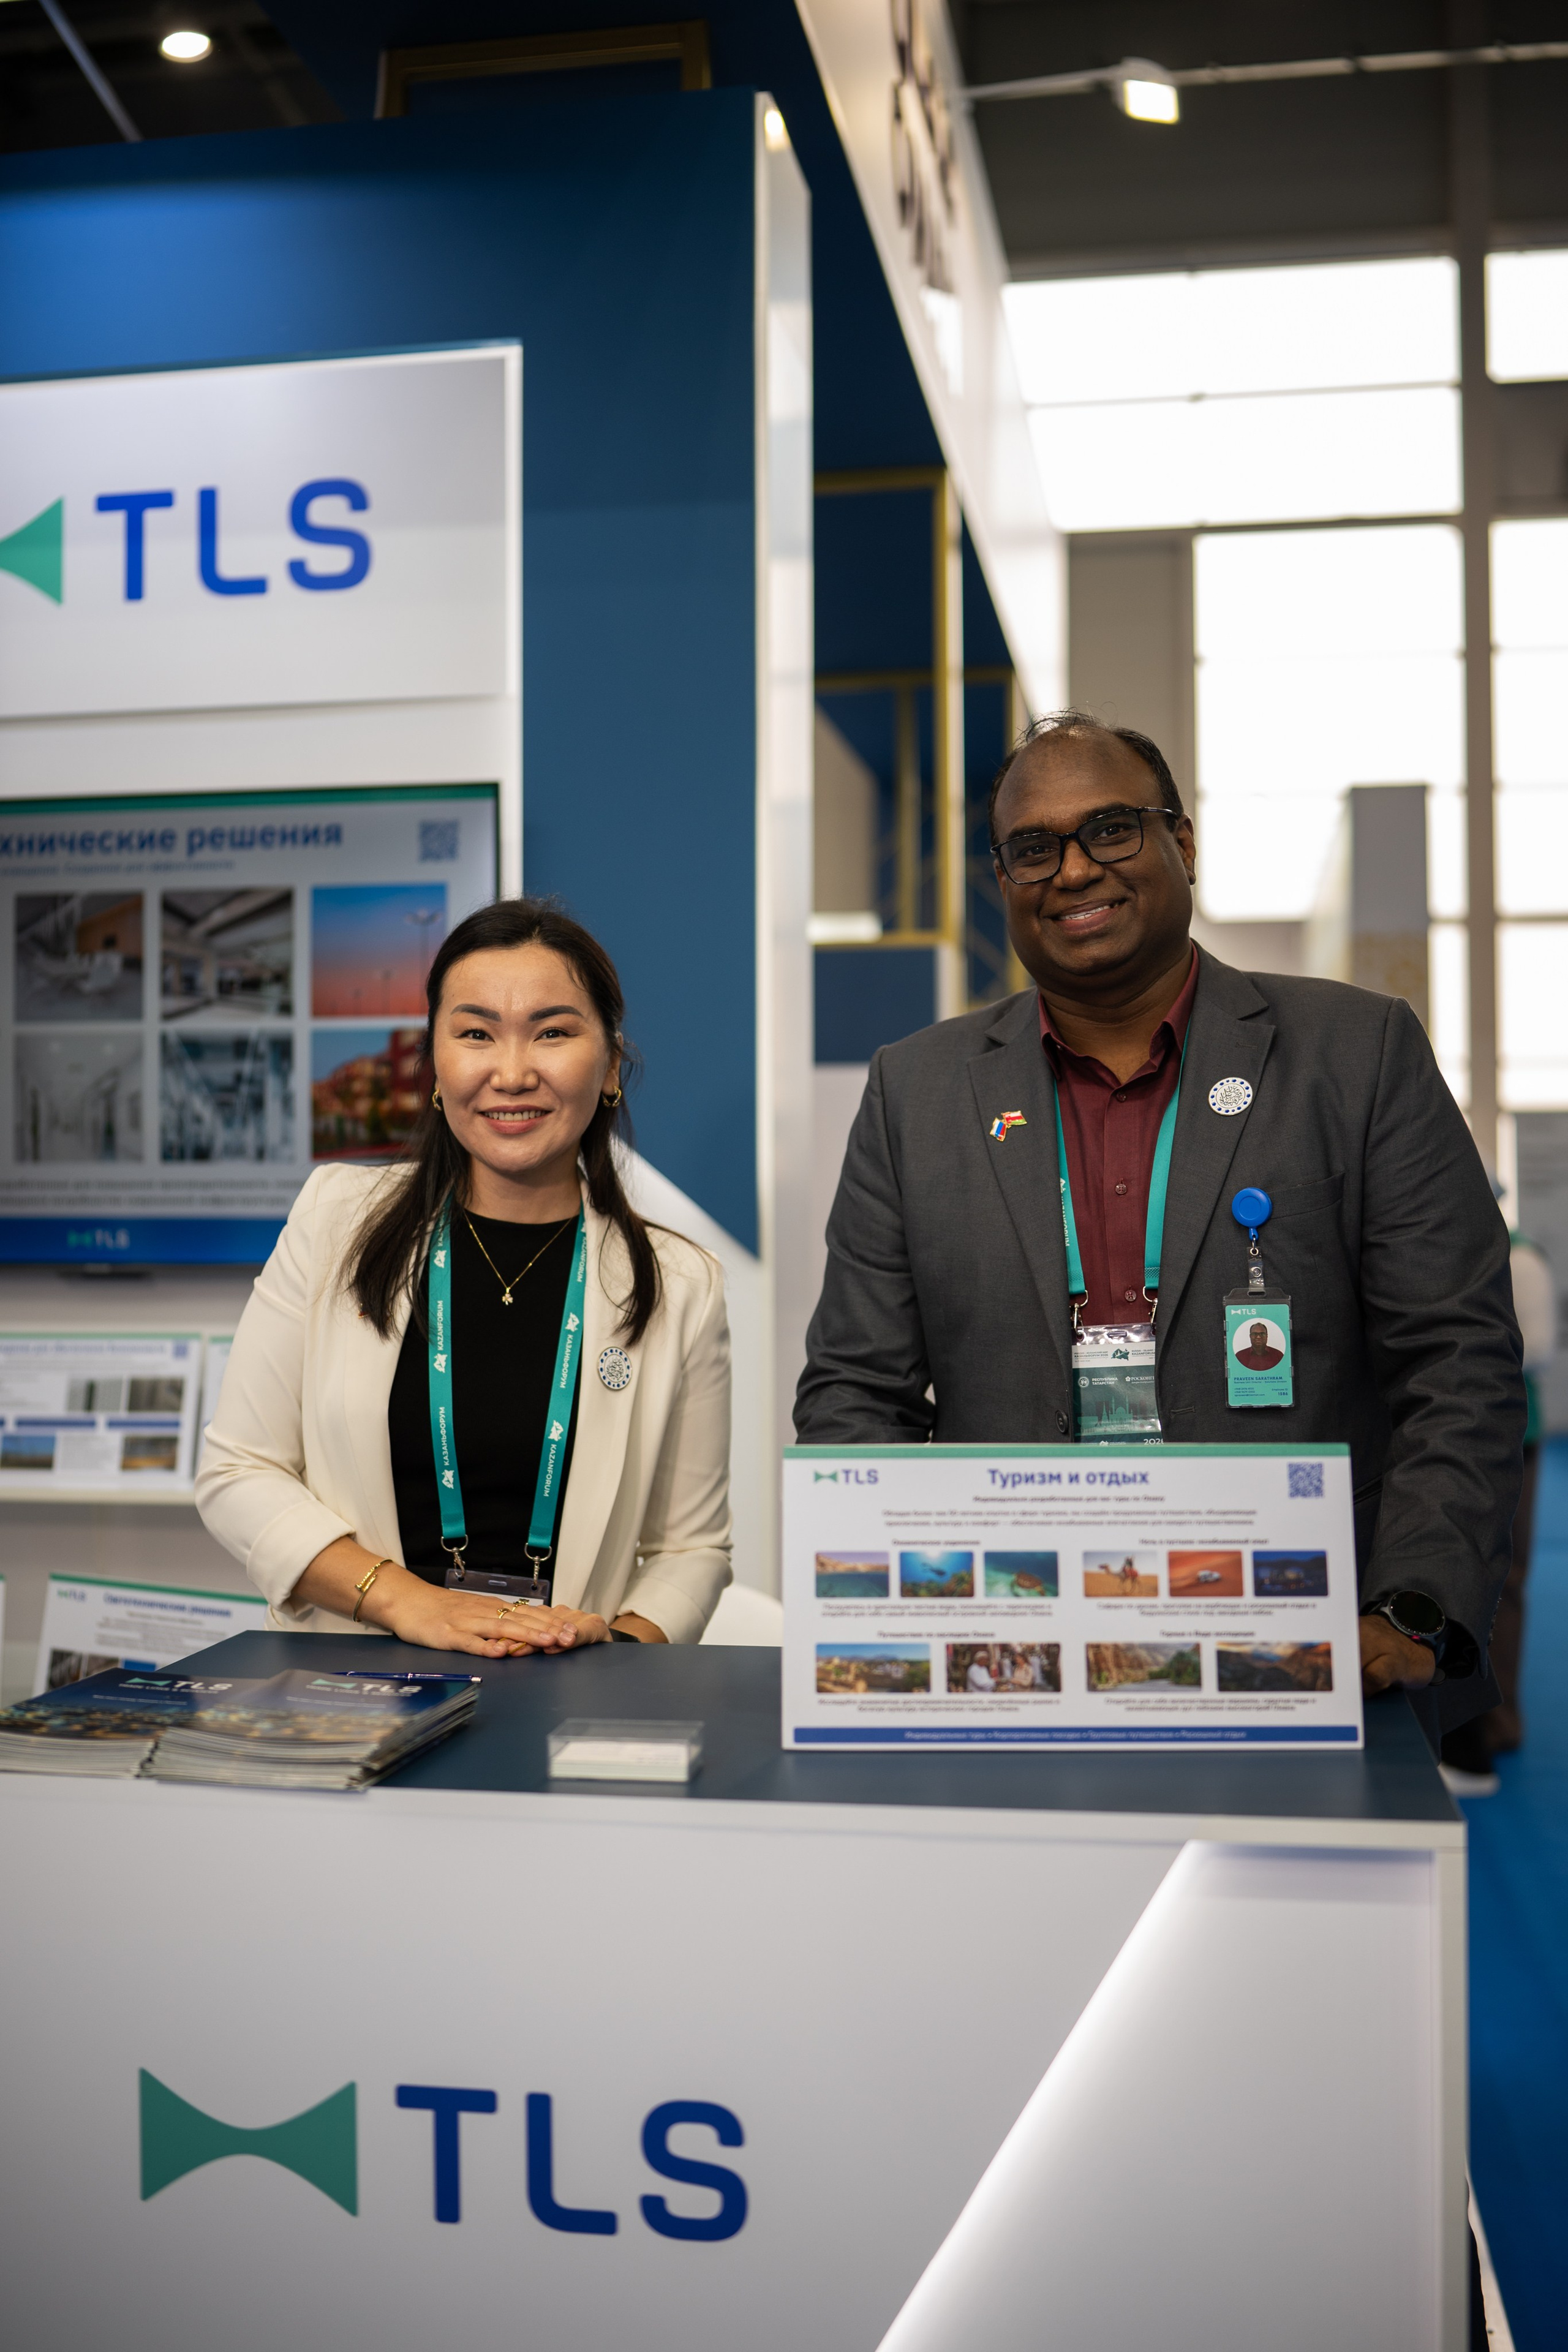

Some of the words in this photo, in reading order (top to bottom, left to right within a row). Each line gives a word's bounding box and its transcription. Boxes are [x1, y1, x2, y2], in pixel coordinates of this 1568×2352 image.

[95, 477, 372, 601] TLS
[186, 822, 344, 857] решения
[560, 1333, 574, 1389] КАЗАНЬФОРУМ
[439, 1406, 450, 1466] КАЗАНЬФОРУМ
[543, 1444, 557, 1497] KAZANFORUM
[841, 1469, 880, 1485] TLS
[987, 1468, 1063, 1489] Туризм
[1068, 1471, 1080, 1485] и
[1085, 1471, 1150, 1487] отдых
[174, 1680, 233, 1691] TLS
[361, 1683, 423, 1694] TLS
[395, 2084, 749, 2244] TLS
